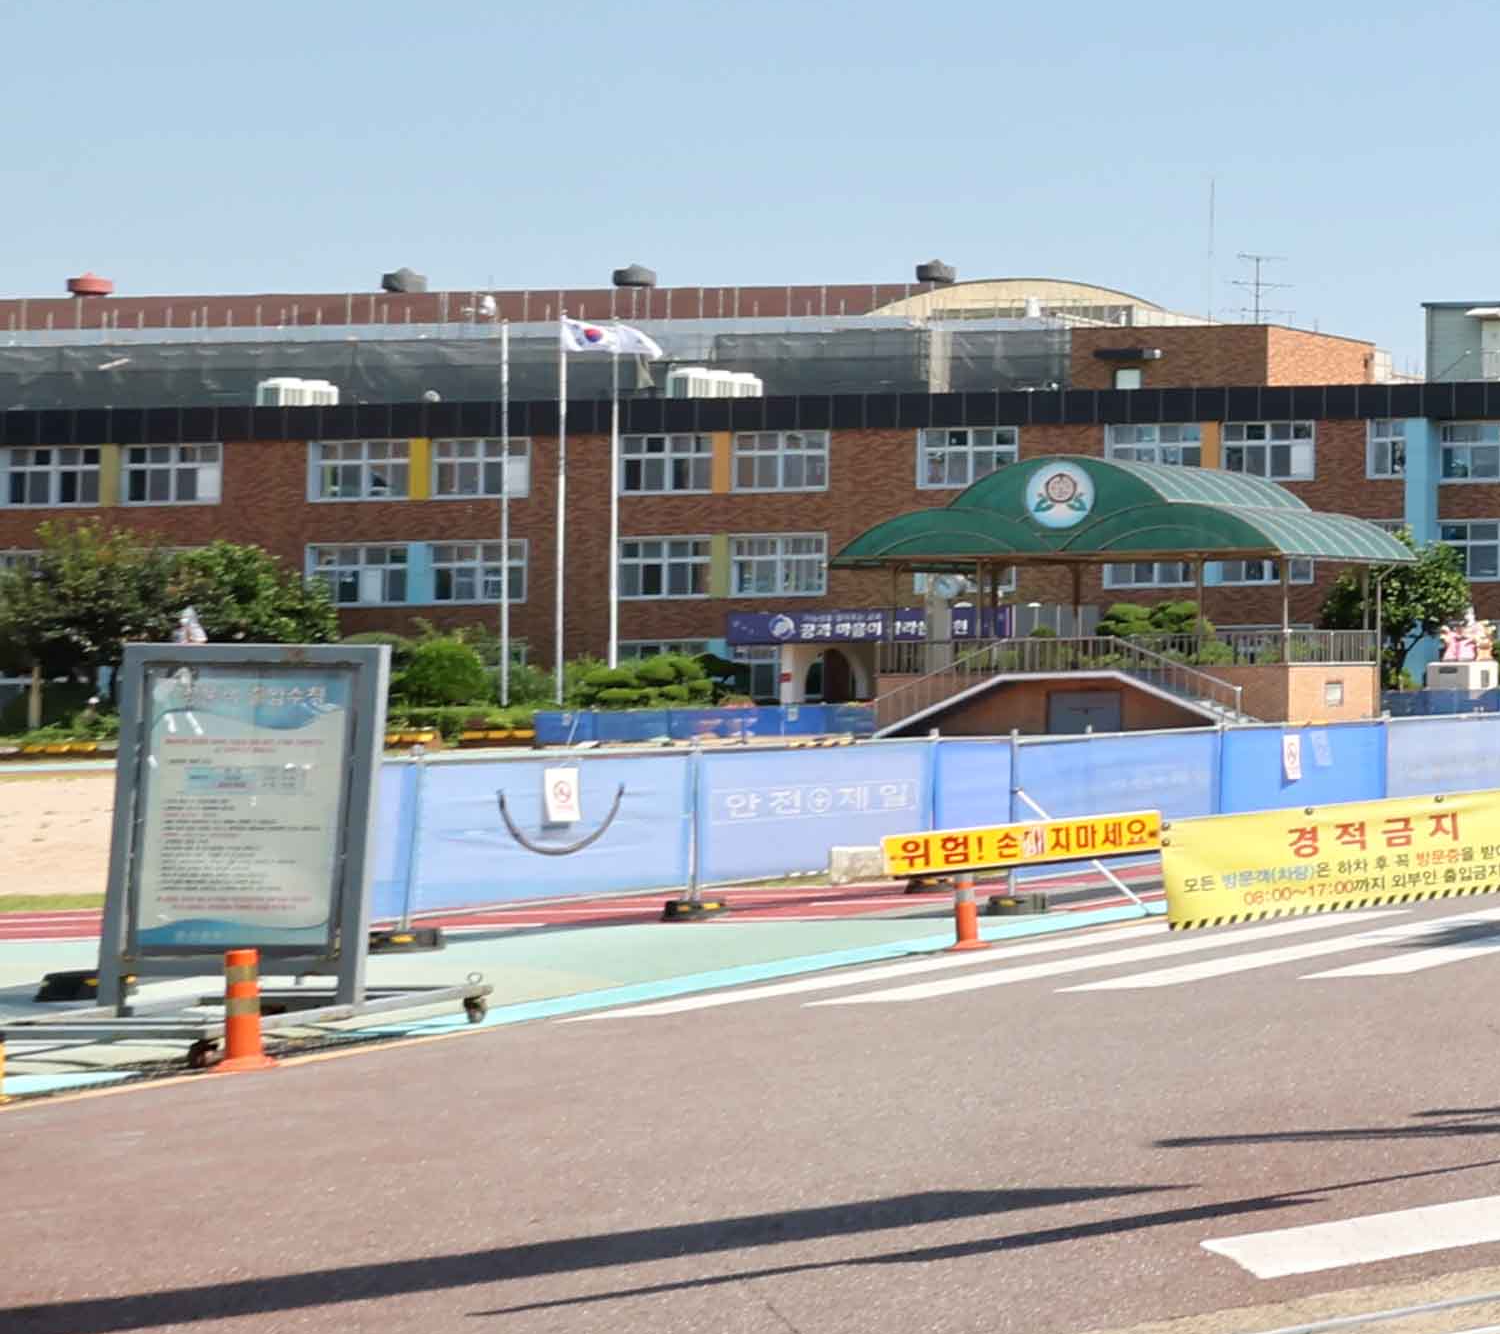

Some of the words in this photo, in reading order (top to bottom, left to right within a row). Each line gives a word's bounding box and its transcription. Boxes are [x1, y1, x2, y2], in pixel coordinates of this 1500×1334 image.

[901, 834, 984, 868] 위험!
[1287, 811, 1460, 859] 경적금지
[1184, 875, 1215, 894] 모든
[1338, 857, 1369, 875] 하차
[1375, 854, 1390, 873] 후
[1395, 852, 1410, 870] 꼭
[1391, 870, 1437, 889] 외부인
